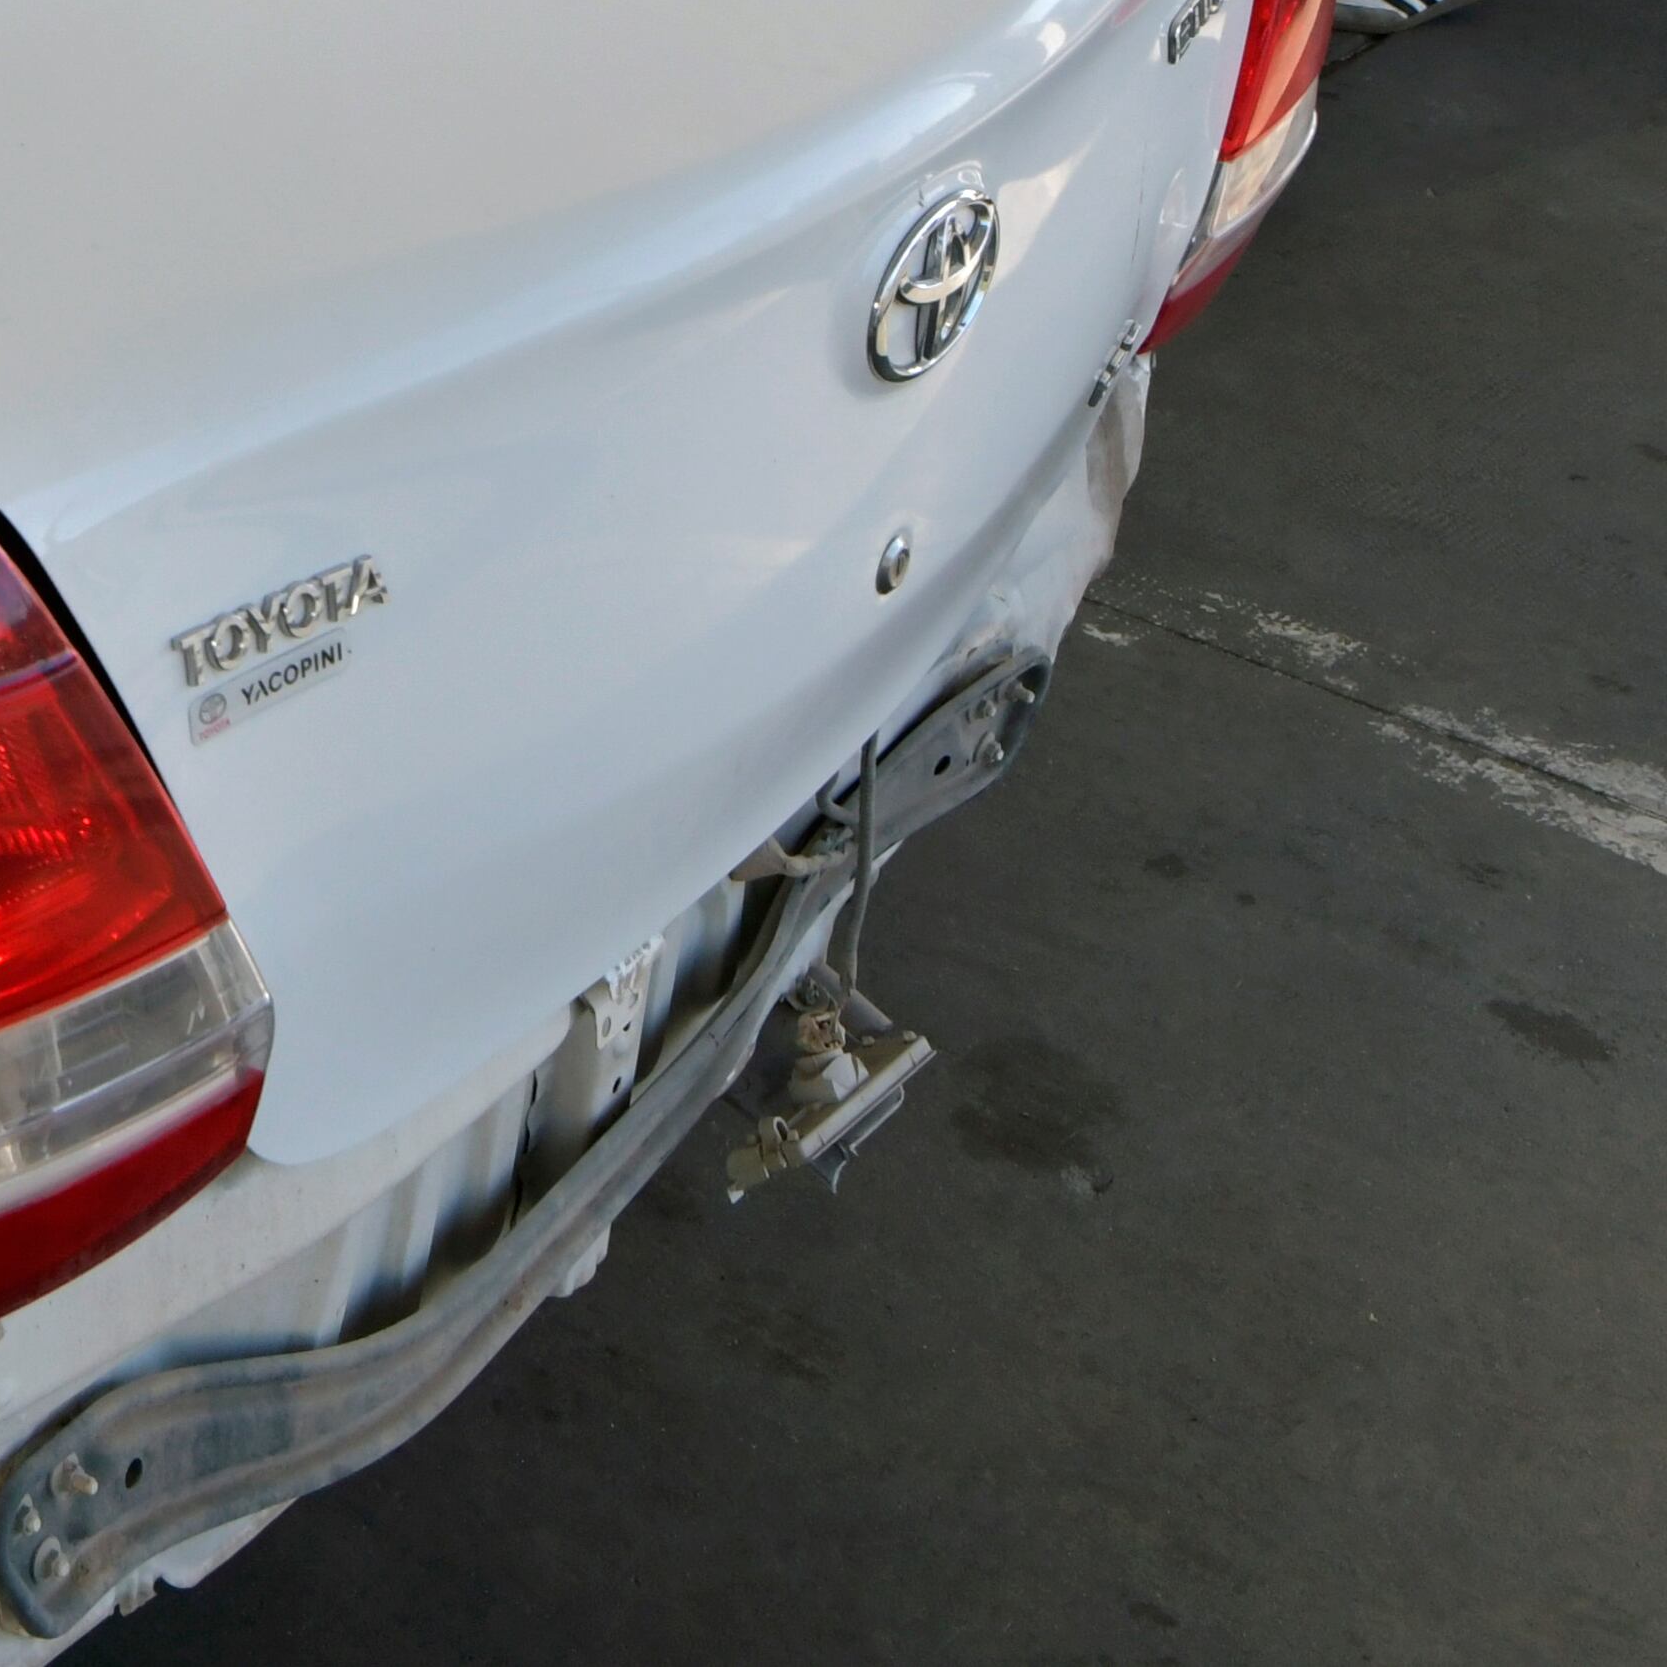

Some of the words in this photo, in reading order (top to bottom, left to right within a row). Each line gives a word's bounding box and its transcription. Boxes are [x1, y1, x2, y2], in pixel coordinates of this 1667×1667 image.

[170, 553, 391, 687] TOYOTA
[241, 641, 343, 706] YACOPINI
[198, 718, 231, 741] TOYOTA
